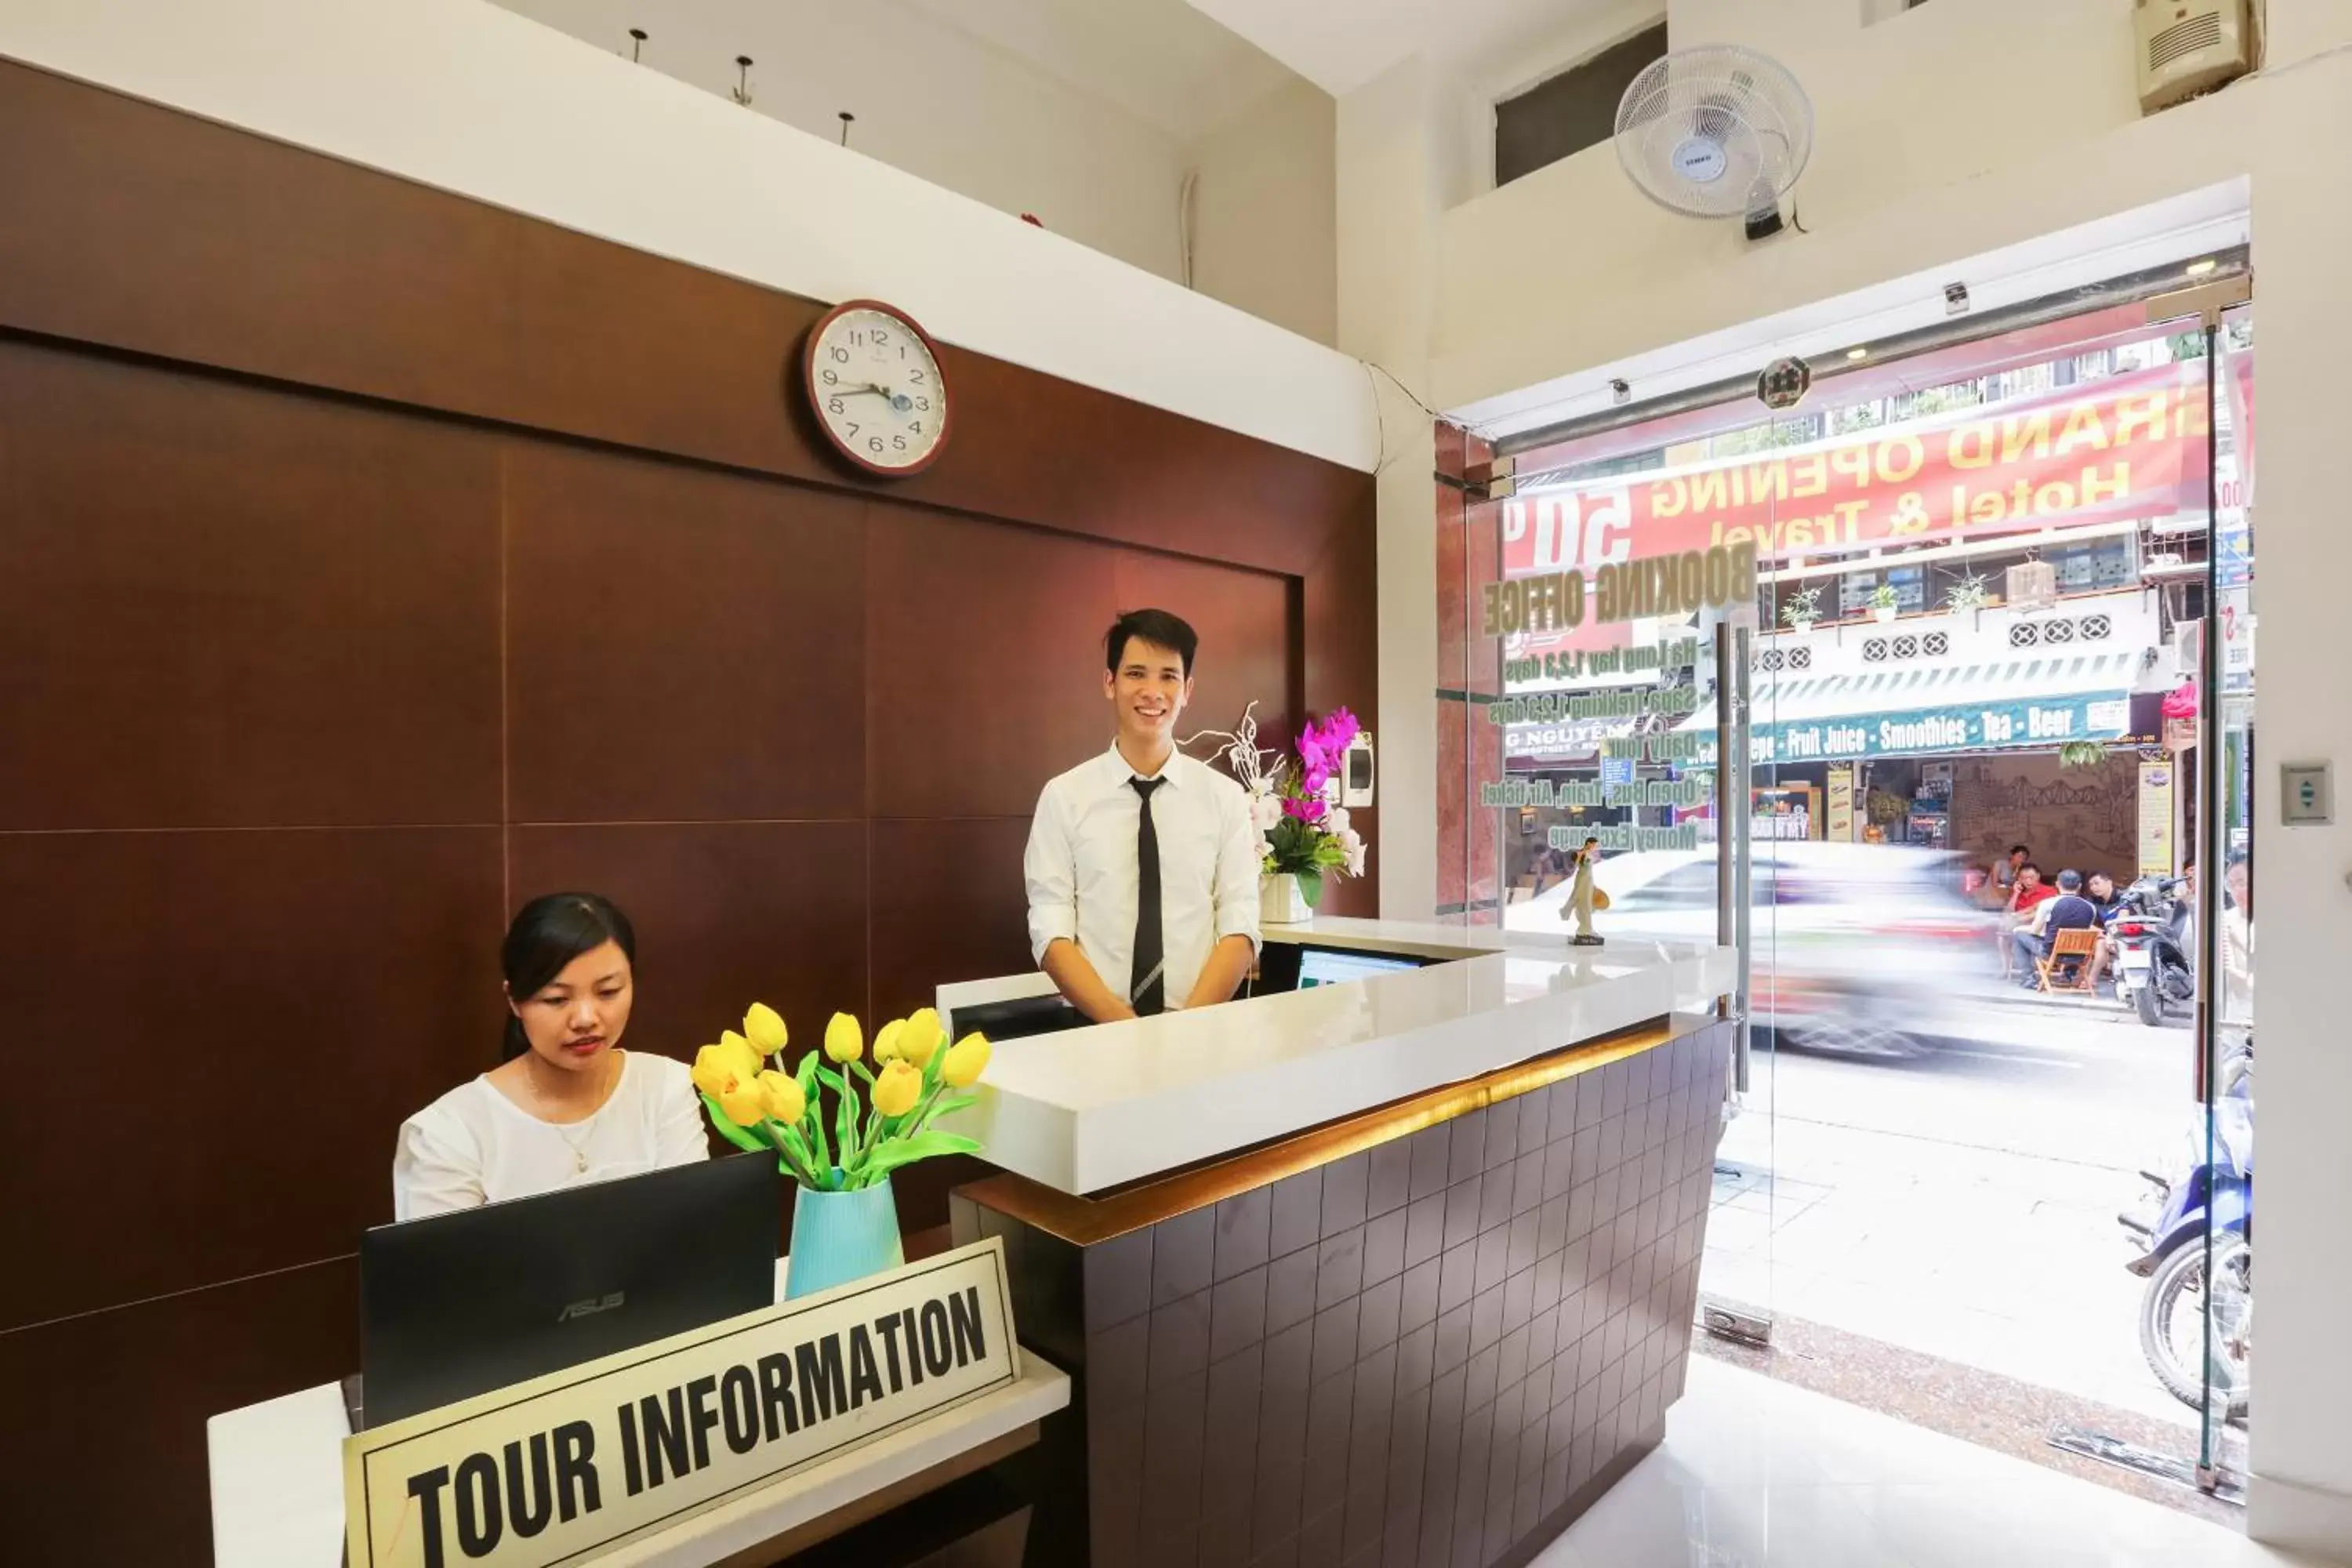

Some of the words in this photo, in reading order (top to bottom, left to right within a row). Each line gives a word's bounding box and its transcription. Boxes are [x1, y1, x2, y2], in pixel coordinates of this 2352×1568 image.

[849, 330, 862, 347] 11
[869, 328, 889, 347] 12
[829, 346, 849, 364] 10
[899, 346, 905, 360] 1
[822, 369, 838, 386] 9
[910, 368, 925, 385] 2
[829, 398, 844, 416] 8
[915, 395, 930, 412] 3
[846, 422, 860, 438] 7
[907, 420, 921, 435] 4
[868, 436, 884, 453] 6
[891, 435, 907, 451] 5
[1788, 728, 1820, 757] Fruit
[1824, 724, 1866, 755] Juice
[1880, 717, 1966, 750] Smoothies
[1981, 710, 2012, 742] Tea
[2028, 706, 2074, 739] Beer
[557, 1290, 625, 1323] ASUS
[407, 1420, 602, 1568] TOUR
[617, 1286, 987, 1499] INFORMATION
